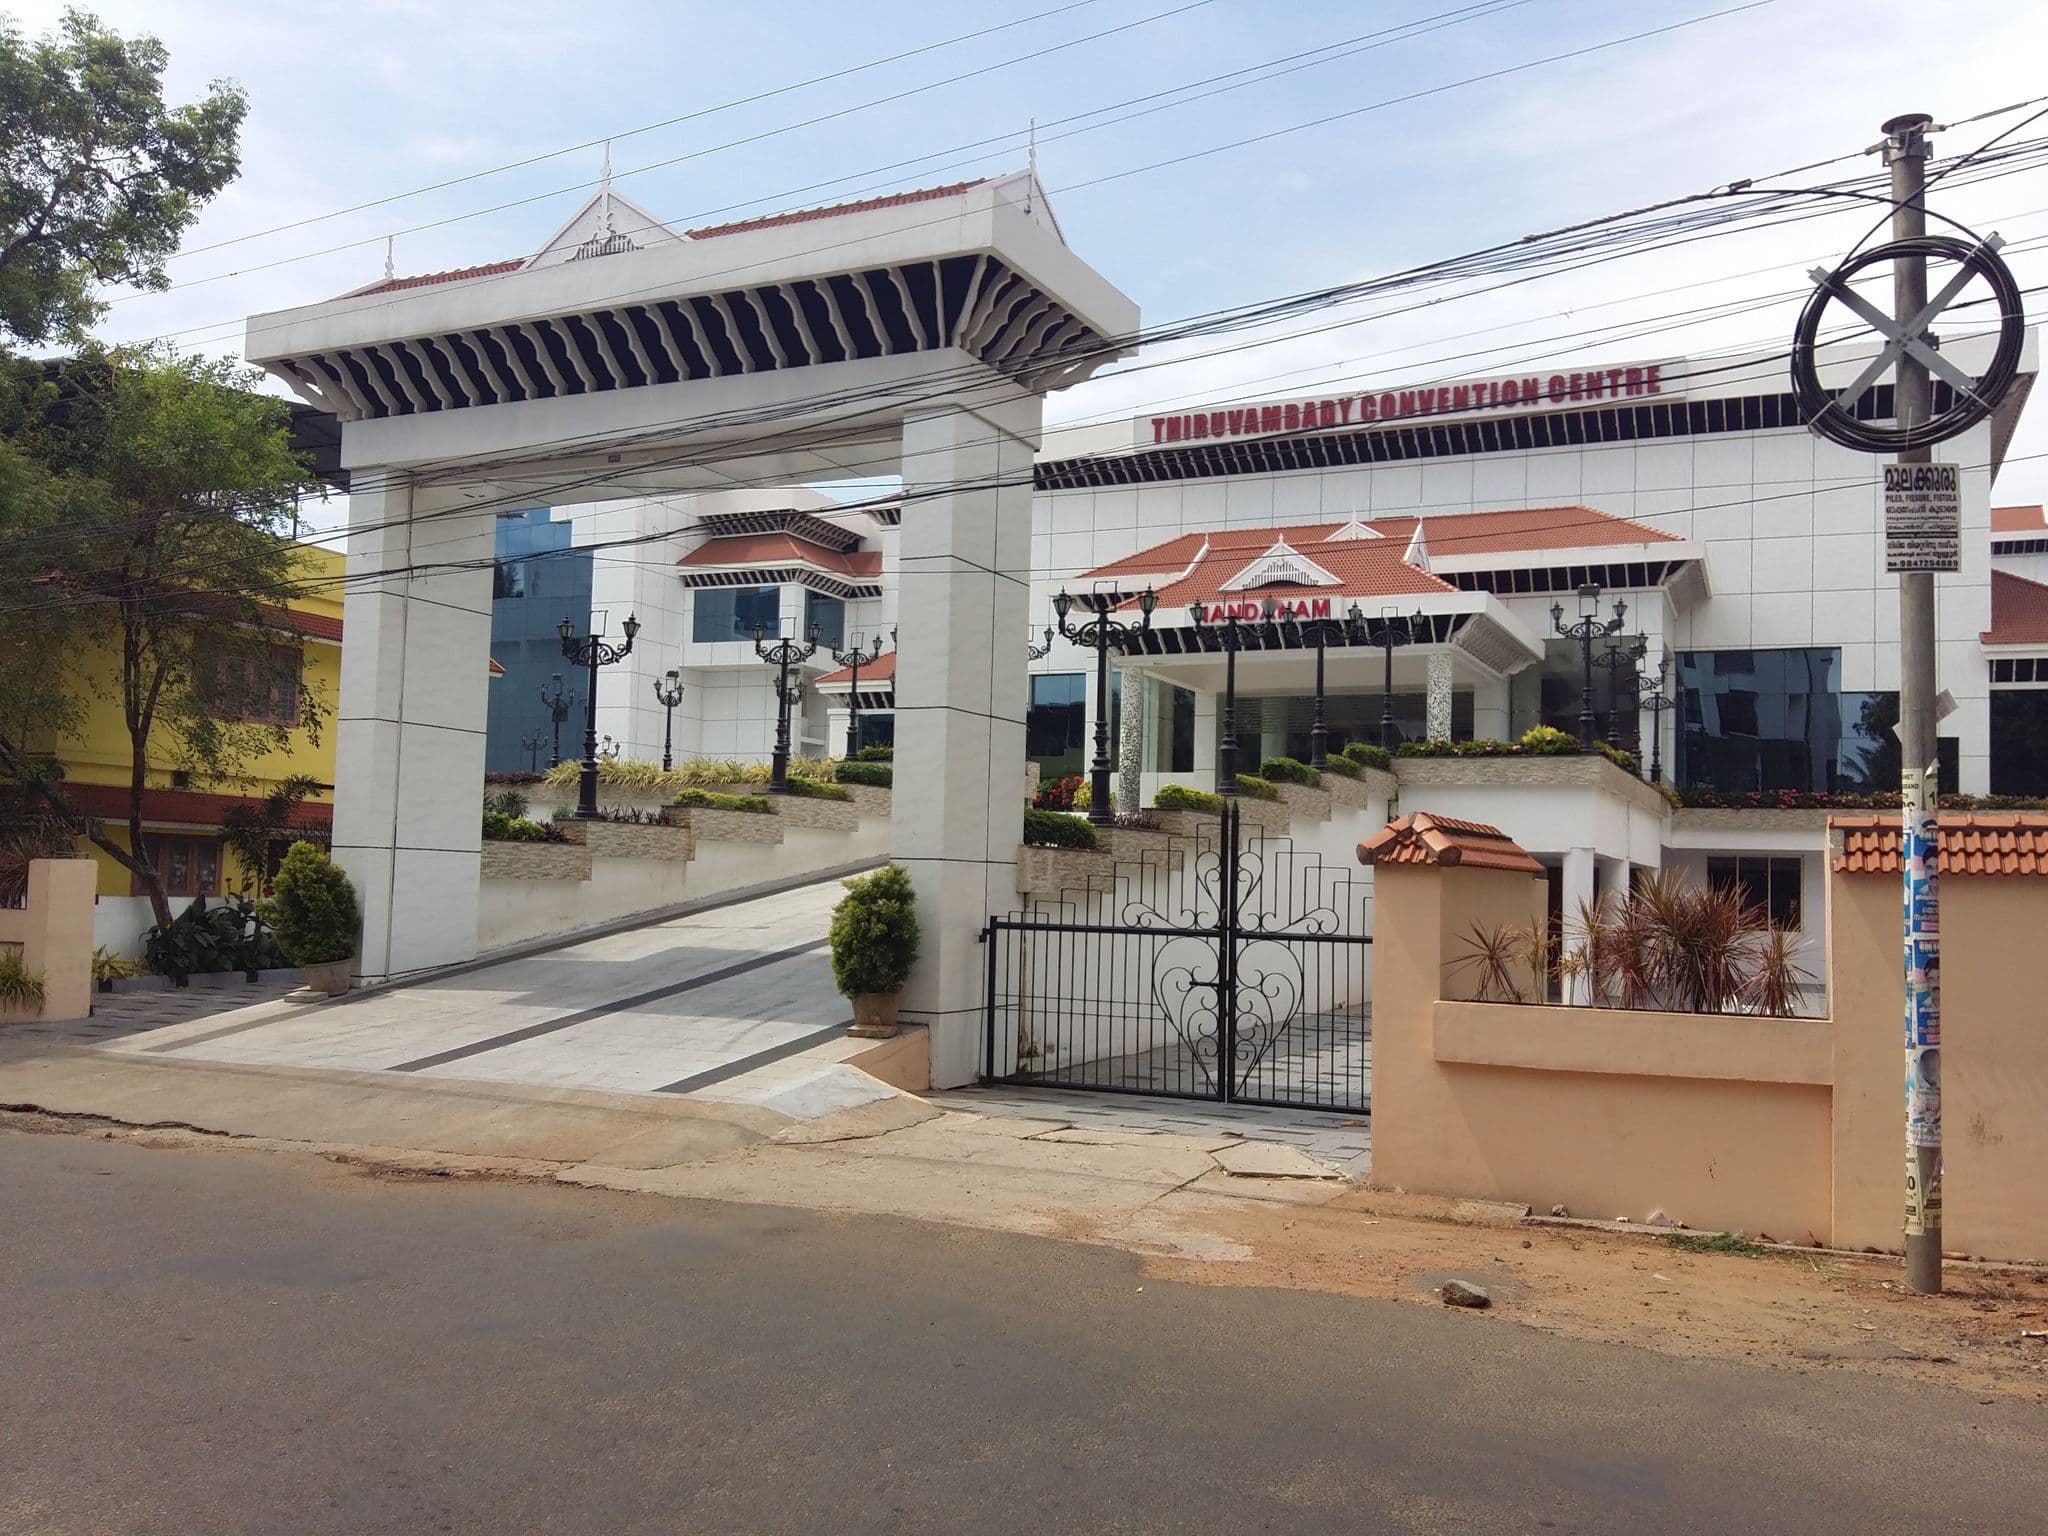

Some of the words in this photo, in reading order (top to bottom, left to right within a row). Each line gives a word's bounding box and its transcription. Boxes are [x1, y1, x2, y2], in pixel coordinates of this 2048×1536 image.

[1151, 397, 1353, 444] THIRUVAMBADY
[1360, 377, 1540, 422] CONVENTION
[1547, 365, 1662, 404] CENTRE
[1200, 598, 1330, 623] ANDNAM
